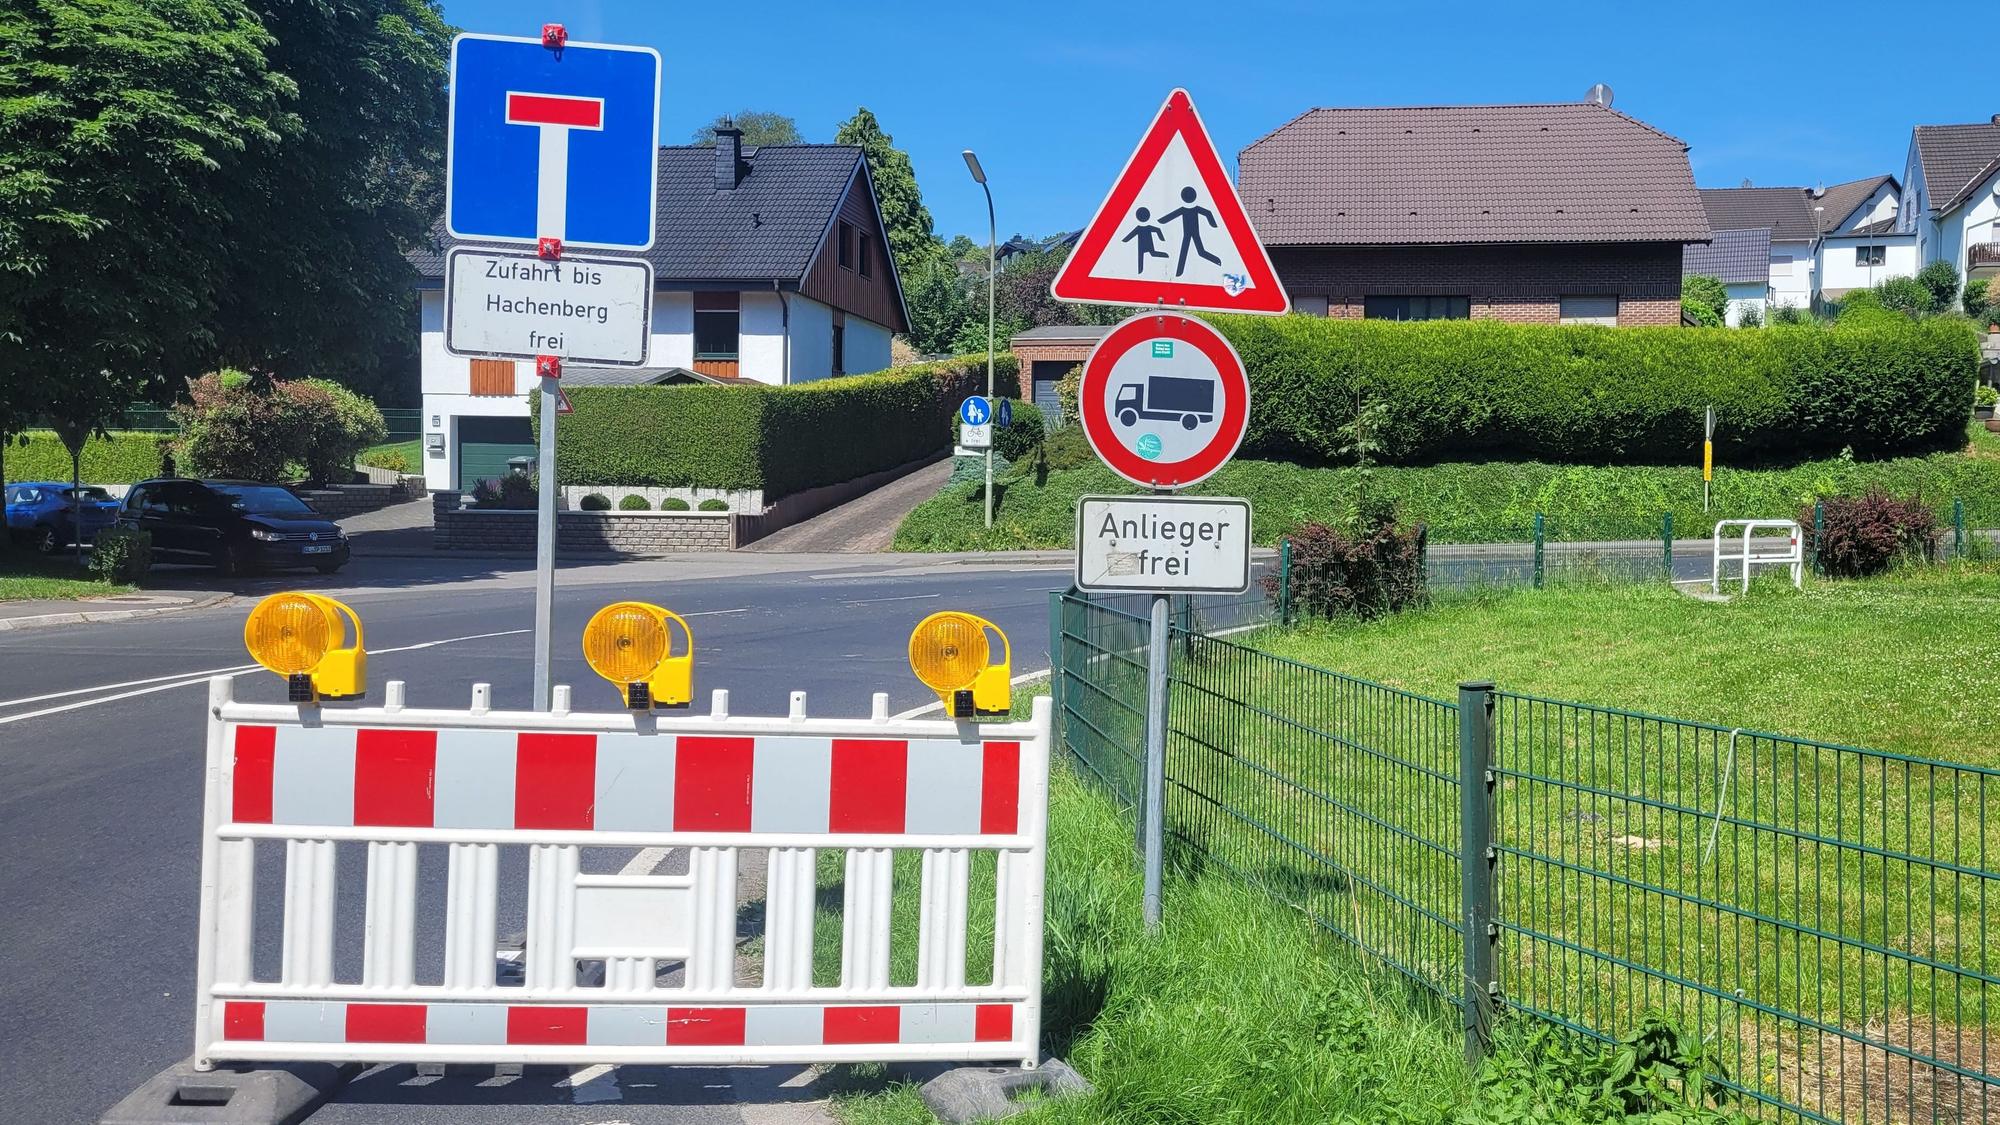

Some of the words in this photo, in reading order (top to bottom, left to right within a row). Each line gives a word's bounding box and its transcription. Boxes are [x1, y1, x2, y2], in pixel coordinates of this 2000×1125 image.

[485, 260, 561, 283] Zufahrt
[573, 266, 602, 285] bis
[486, 294, 608, 324] Hachenberg
[529, 330, 564, 350] frei
[1098, 512, 1230, 548] Anlieger
[1138, 549, 1190, 576] frei
